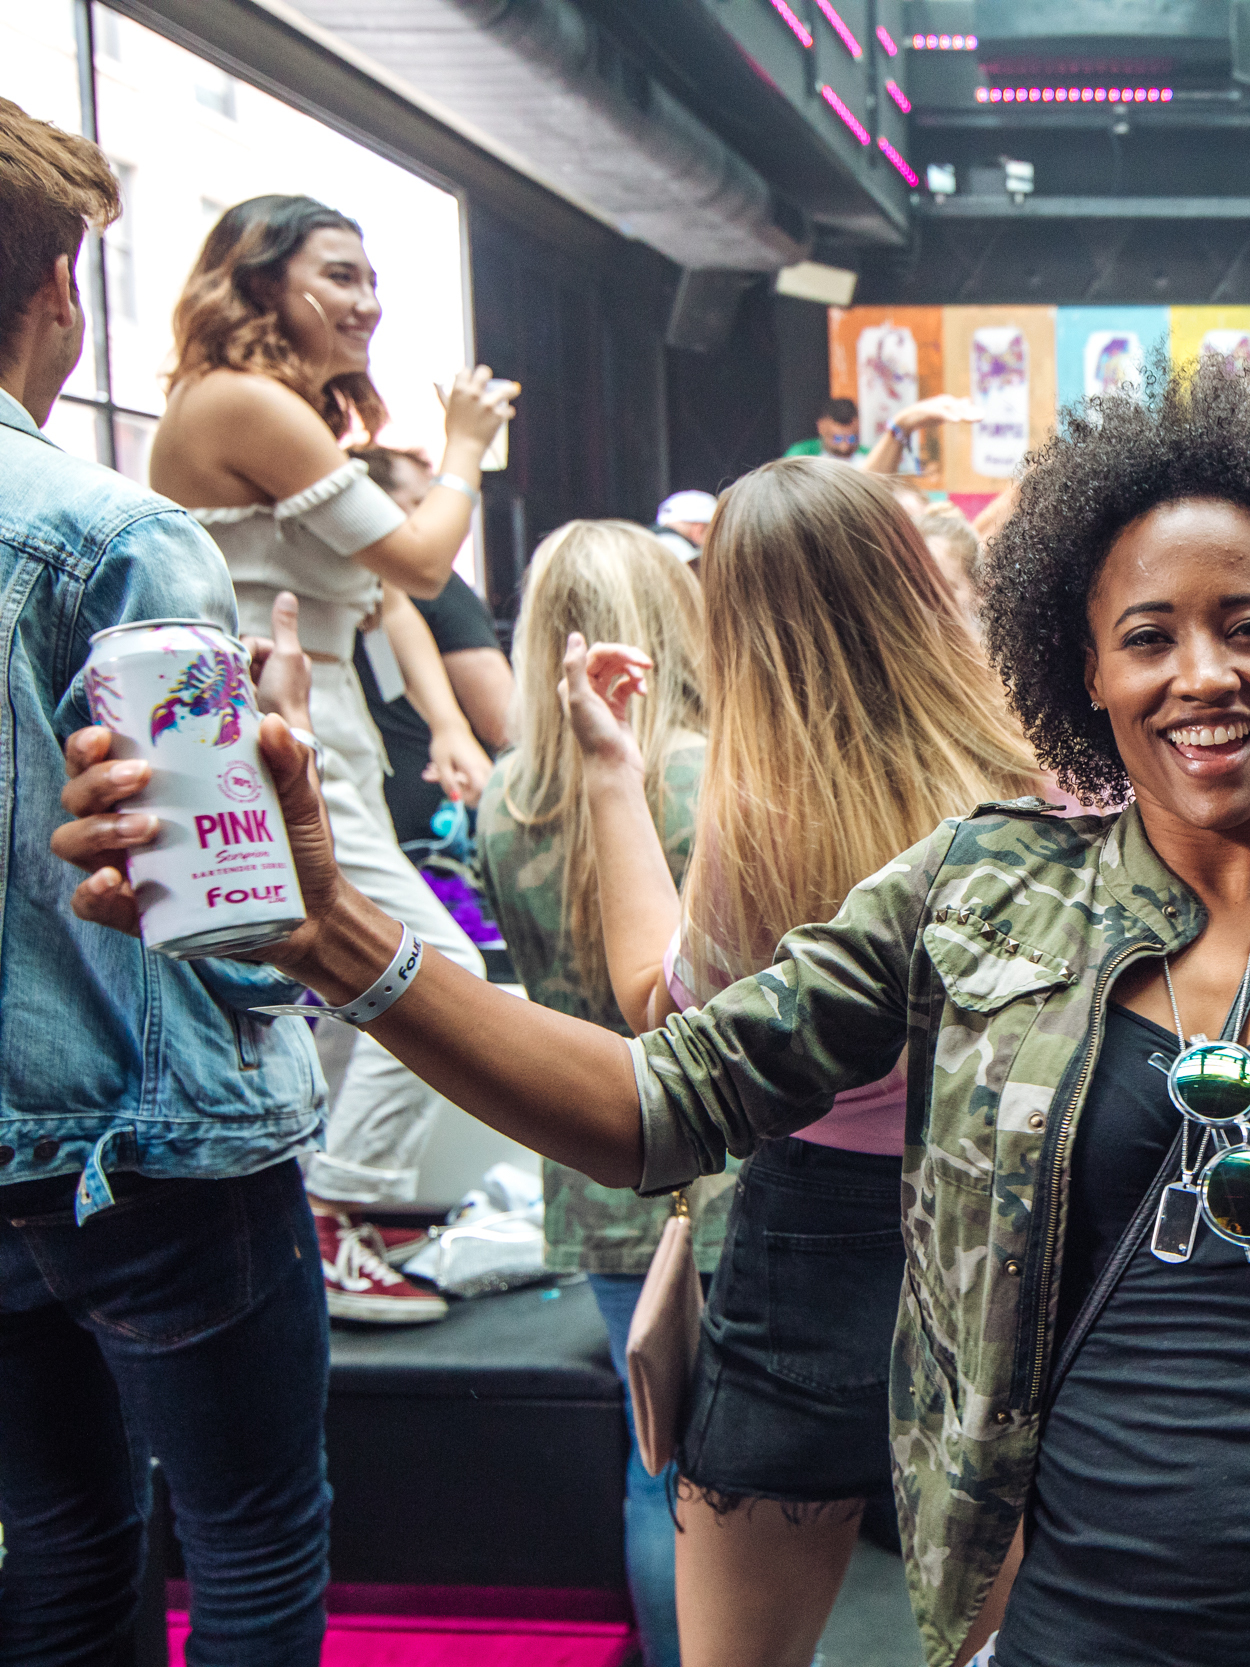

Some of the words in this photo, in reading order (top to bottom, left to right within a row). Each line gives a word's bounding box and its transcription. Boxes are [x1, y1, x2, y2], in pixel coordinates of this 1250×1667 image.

[193, 809, 274, 849] PINK
[215, 849, 269, 863] Scorpion
[191, 864, 257, 880] BARTENDER
